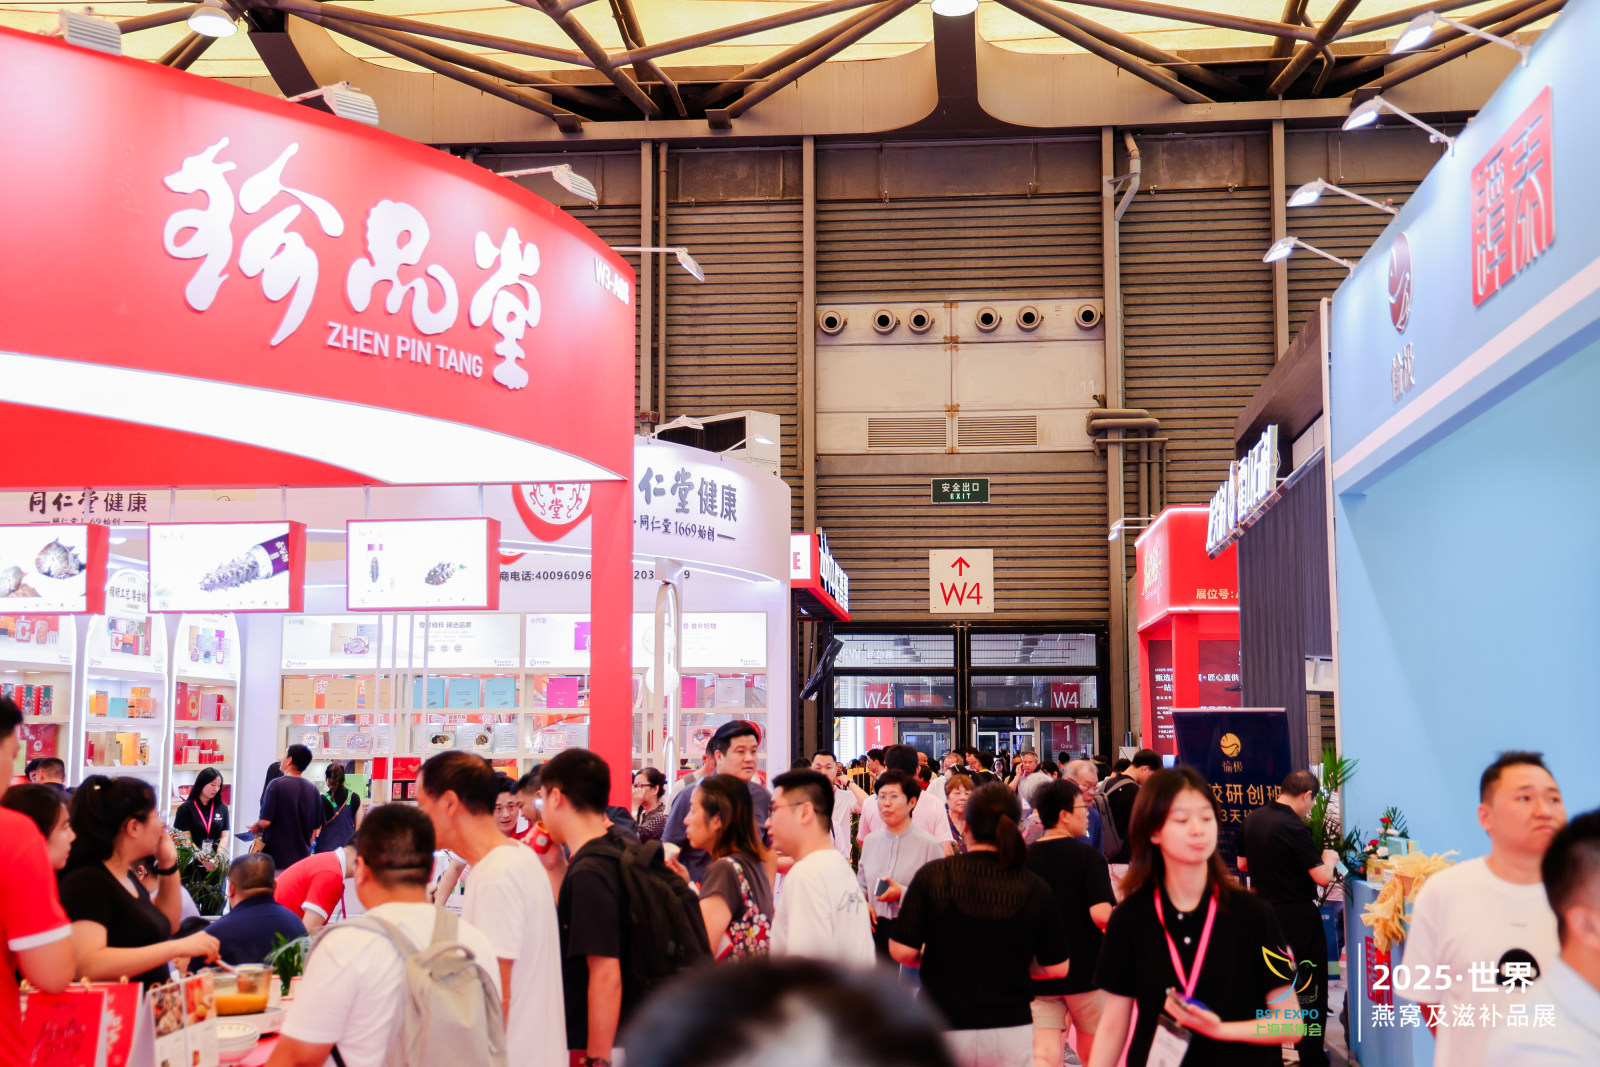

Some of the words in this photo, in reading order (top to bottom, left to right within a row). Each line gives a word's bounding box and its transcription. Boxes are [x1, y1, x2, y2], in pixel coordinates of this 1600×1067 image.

[327, 322, 389, 358] ZHEN
[397, 335, 431, 365] PIN
[436, 345, 484, 378] TANG
[638, 467, 737, 522] 仁堂健康
[941, 482, 980, 493] 安全出口
[940, 582, 983, 606] W4
[864, 692, 893, 709] W4
[1053, 691, 1079, 708] W4
[874, 725, 881, 742] 1
[1064, 725, 1071, 742] 1
